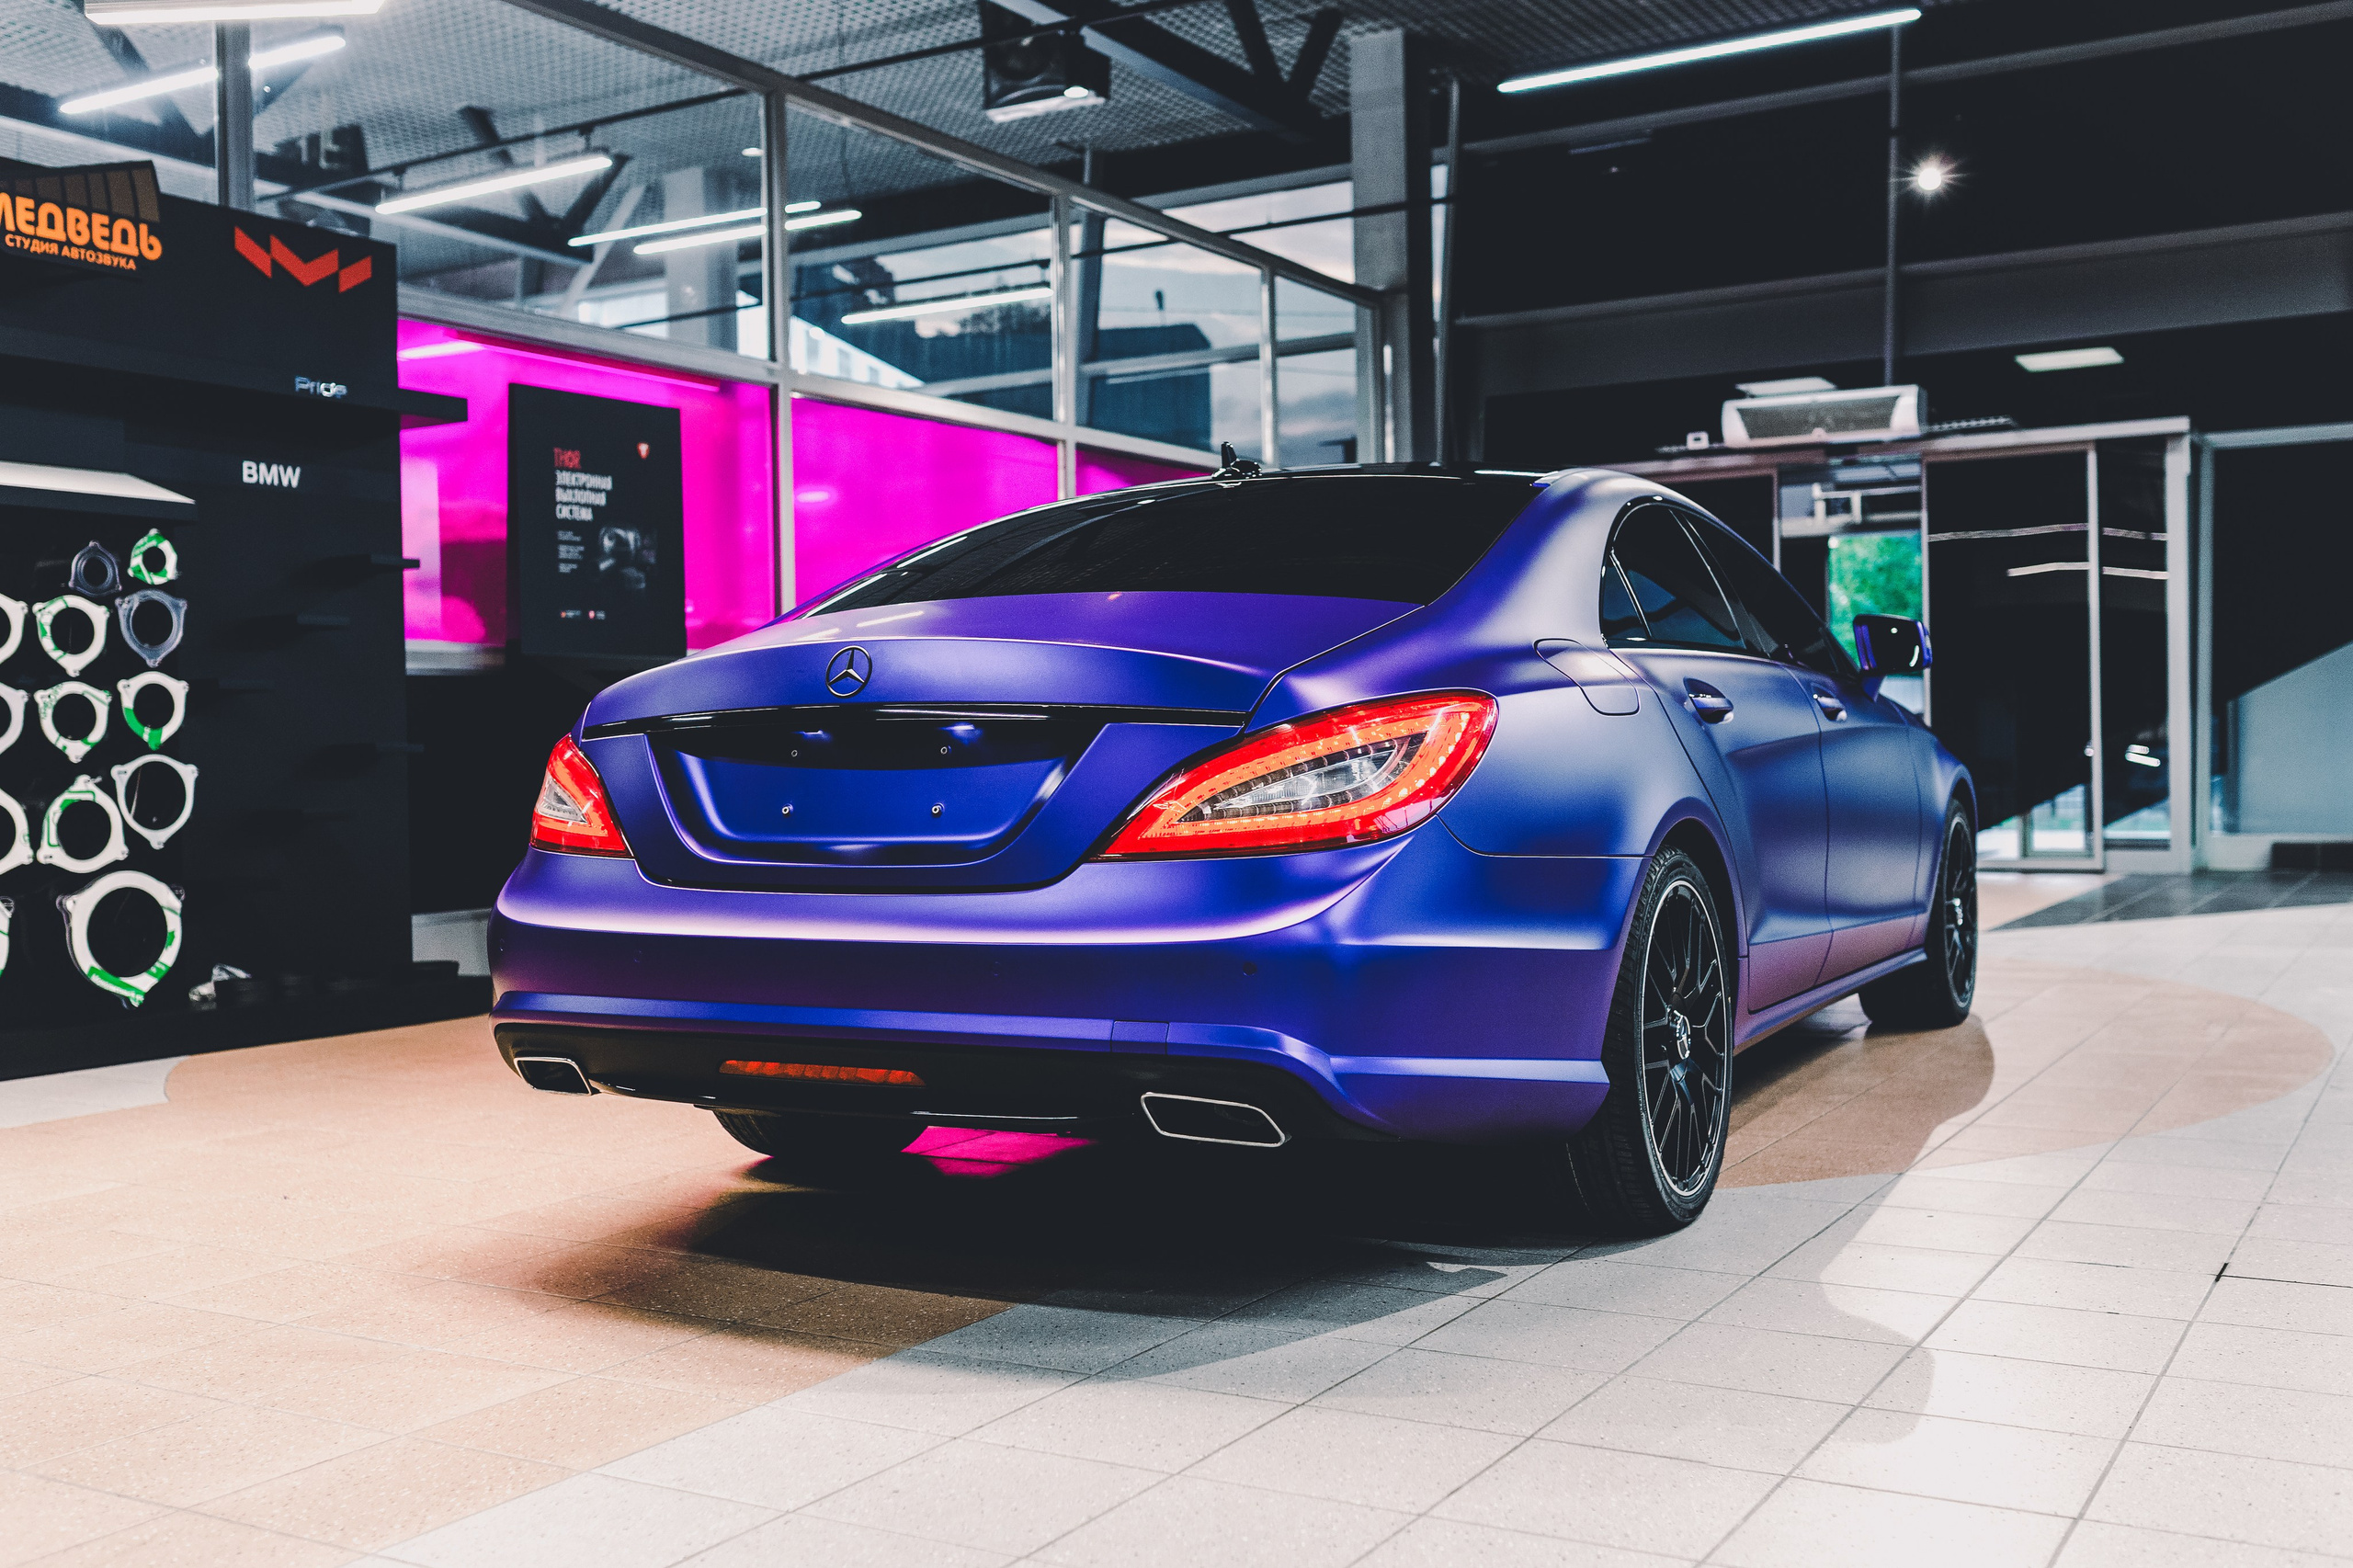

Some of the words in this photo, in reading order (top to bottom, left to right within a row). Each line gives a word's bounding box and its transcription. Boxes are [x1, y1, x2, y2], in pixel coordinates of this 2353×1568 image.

[5, 233, 60, 255] СТУДИЯ
[61, 245, 136, 270] АВТОЗВУКА
[242, 460, 301, 488] BMW
